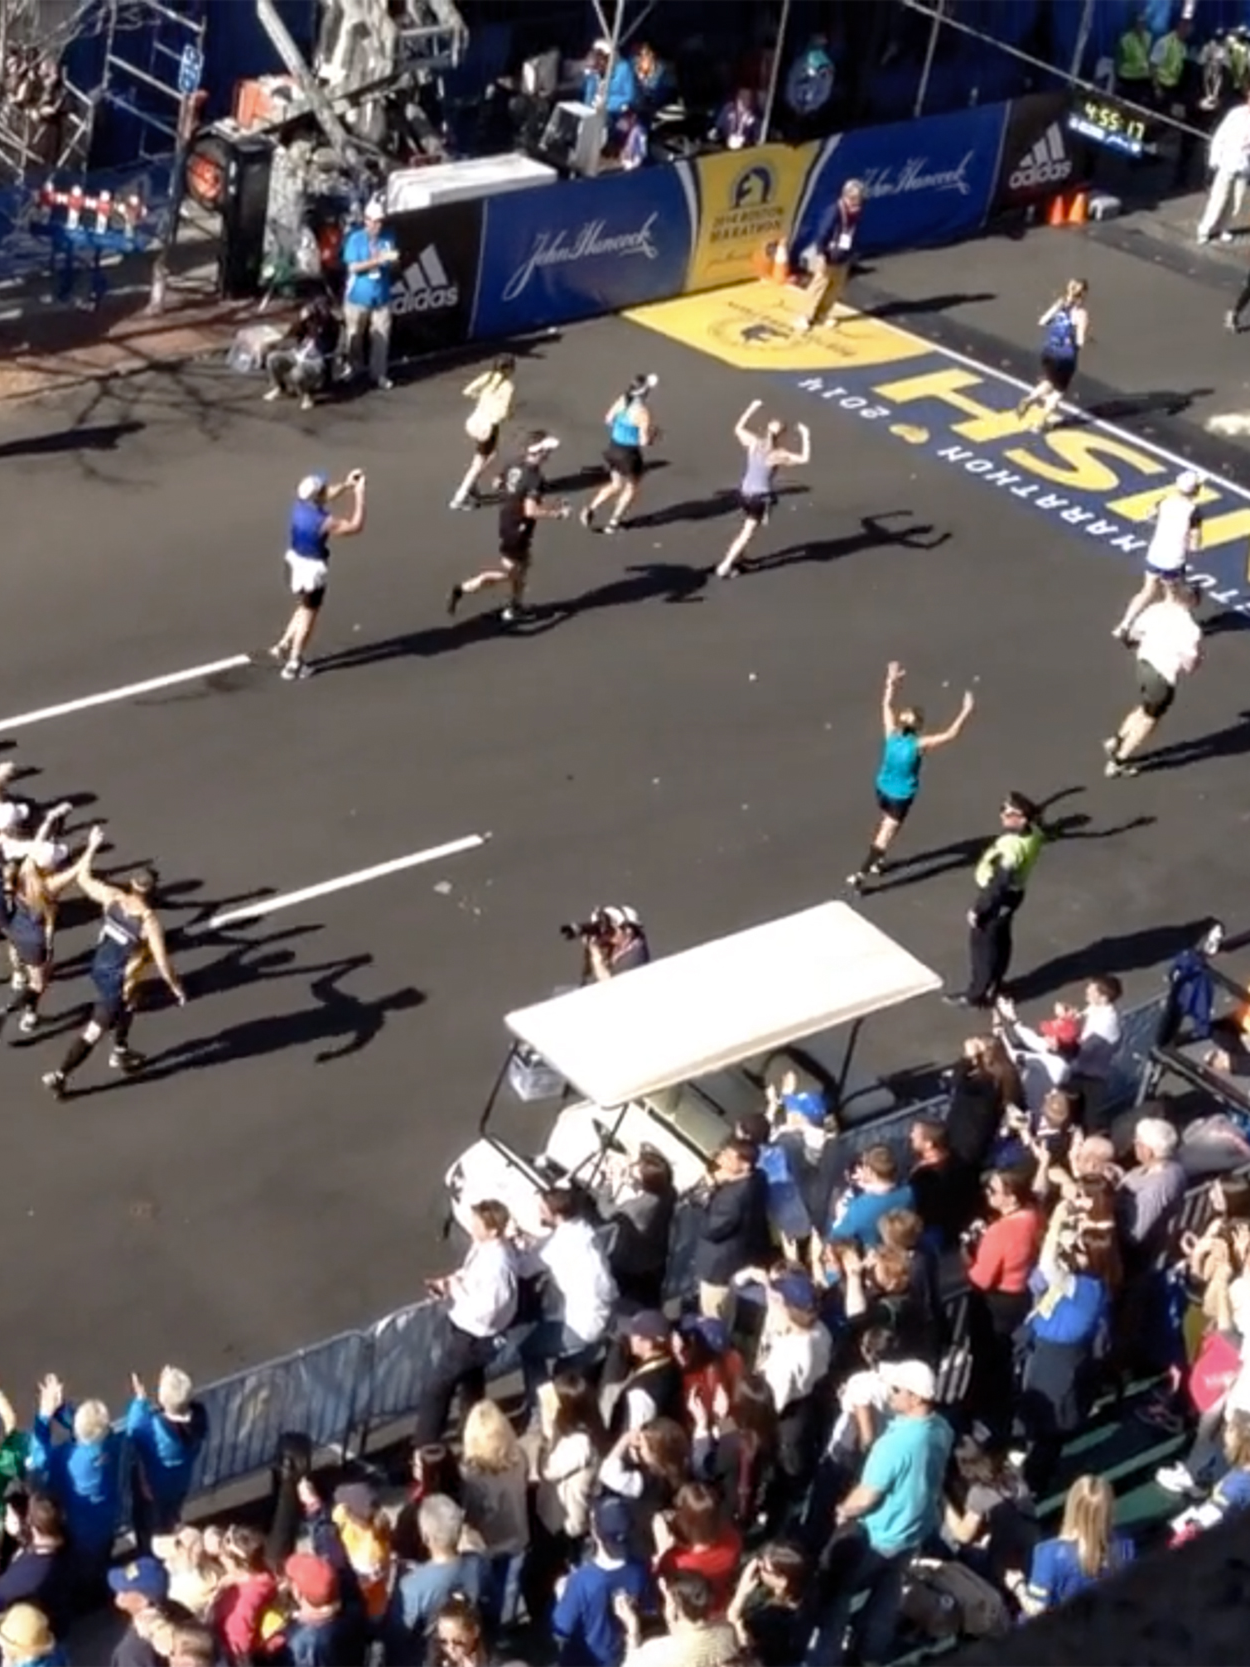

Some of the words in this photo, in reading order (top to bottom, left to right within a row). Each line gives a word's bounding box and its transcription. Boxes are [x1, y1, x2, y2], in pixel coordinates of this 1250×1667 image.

[1008, 160, 1073, 190] adidas
[709, 219, 782, 244] MARATHON
[502, 230, 573, 301] John
[567, 210, 659, 260] Hancock
[391, 284, 459, 316] didas
[797, 376, 891, 421] 2014
[936, 444, 1148, 554] MARATHON
